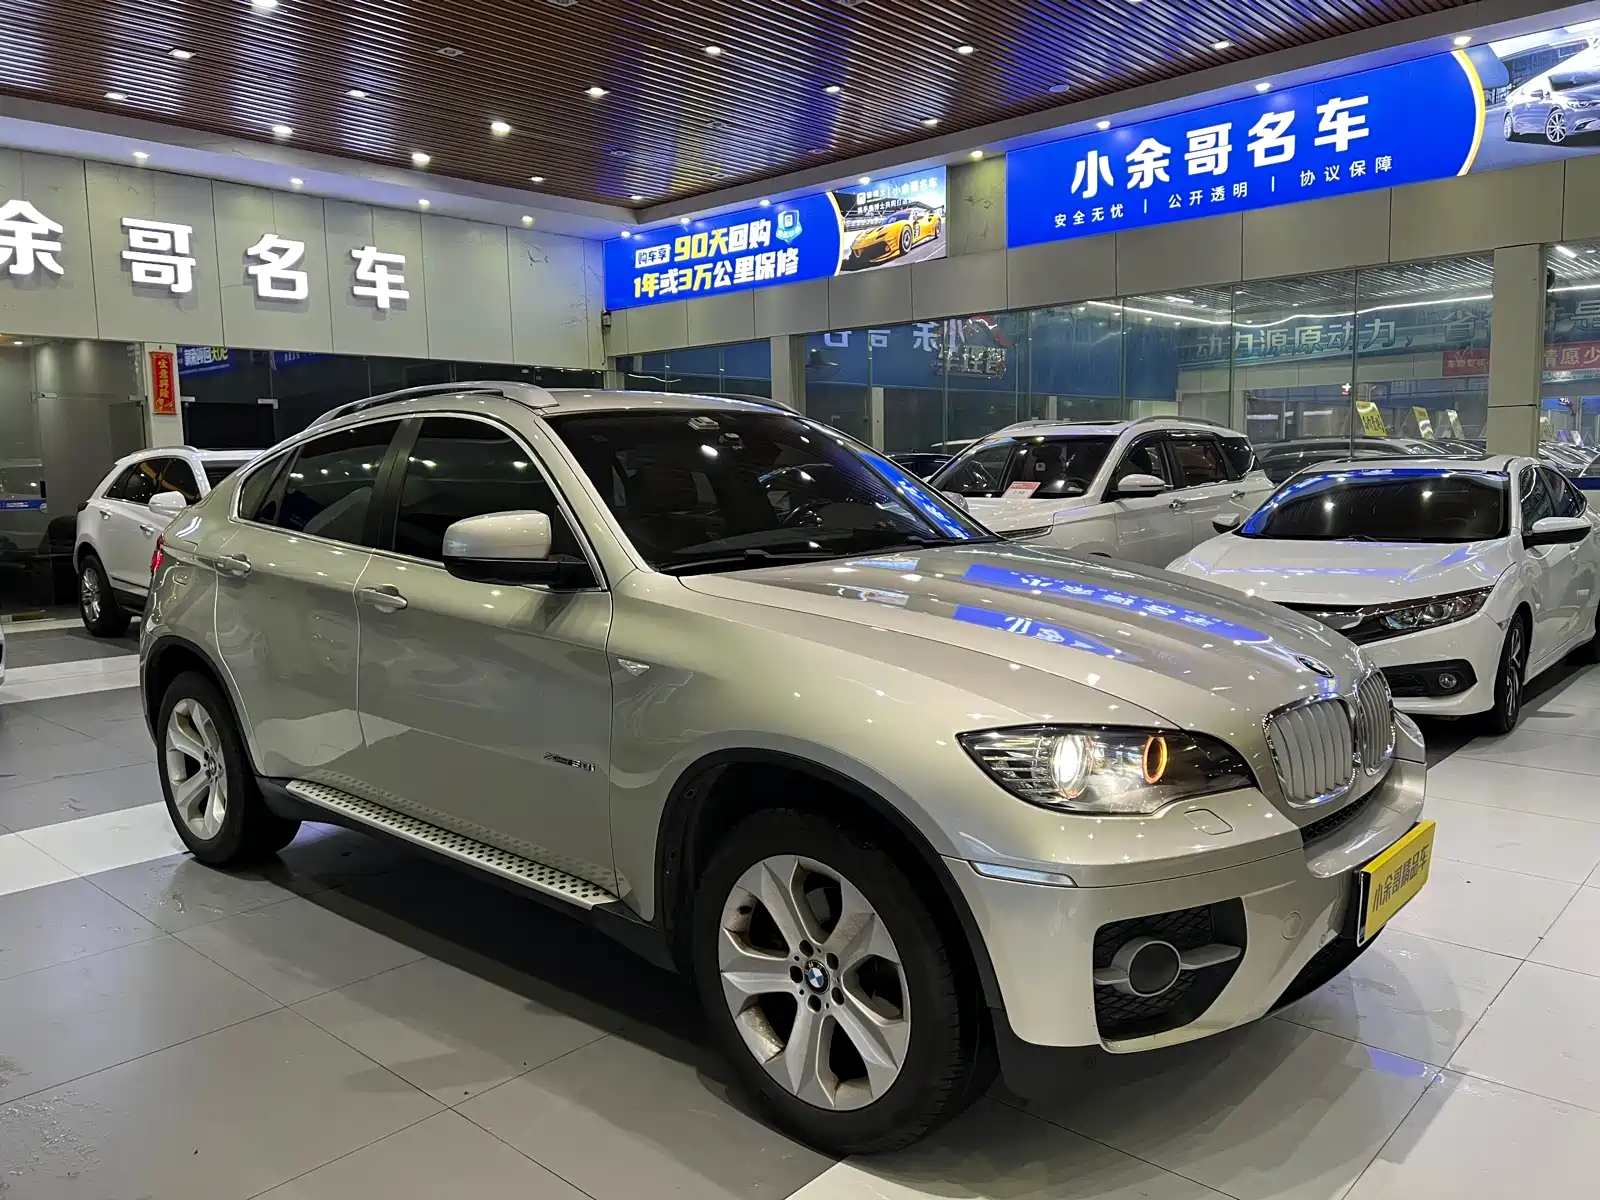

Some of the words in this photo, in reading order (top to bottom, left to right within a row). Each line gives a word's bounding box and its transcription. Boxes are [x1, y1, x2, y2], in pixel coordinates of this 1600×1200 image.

[1070, 95, 1370, 199] 小余哥名车
[1054, 203, 1124, 228] 安全无忧
[1168, 181, 1248, 209] 公开透明
[1300, 155, 1393, 187] 协议保障
[633, 247, 800, 298] 1年或3万公里保修
[637, 246, 667, 265] 购车享
[674, 219, 772, 262] 90天回购
[1372, 843, 1429, 913] 小余哥精品车
